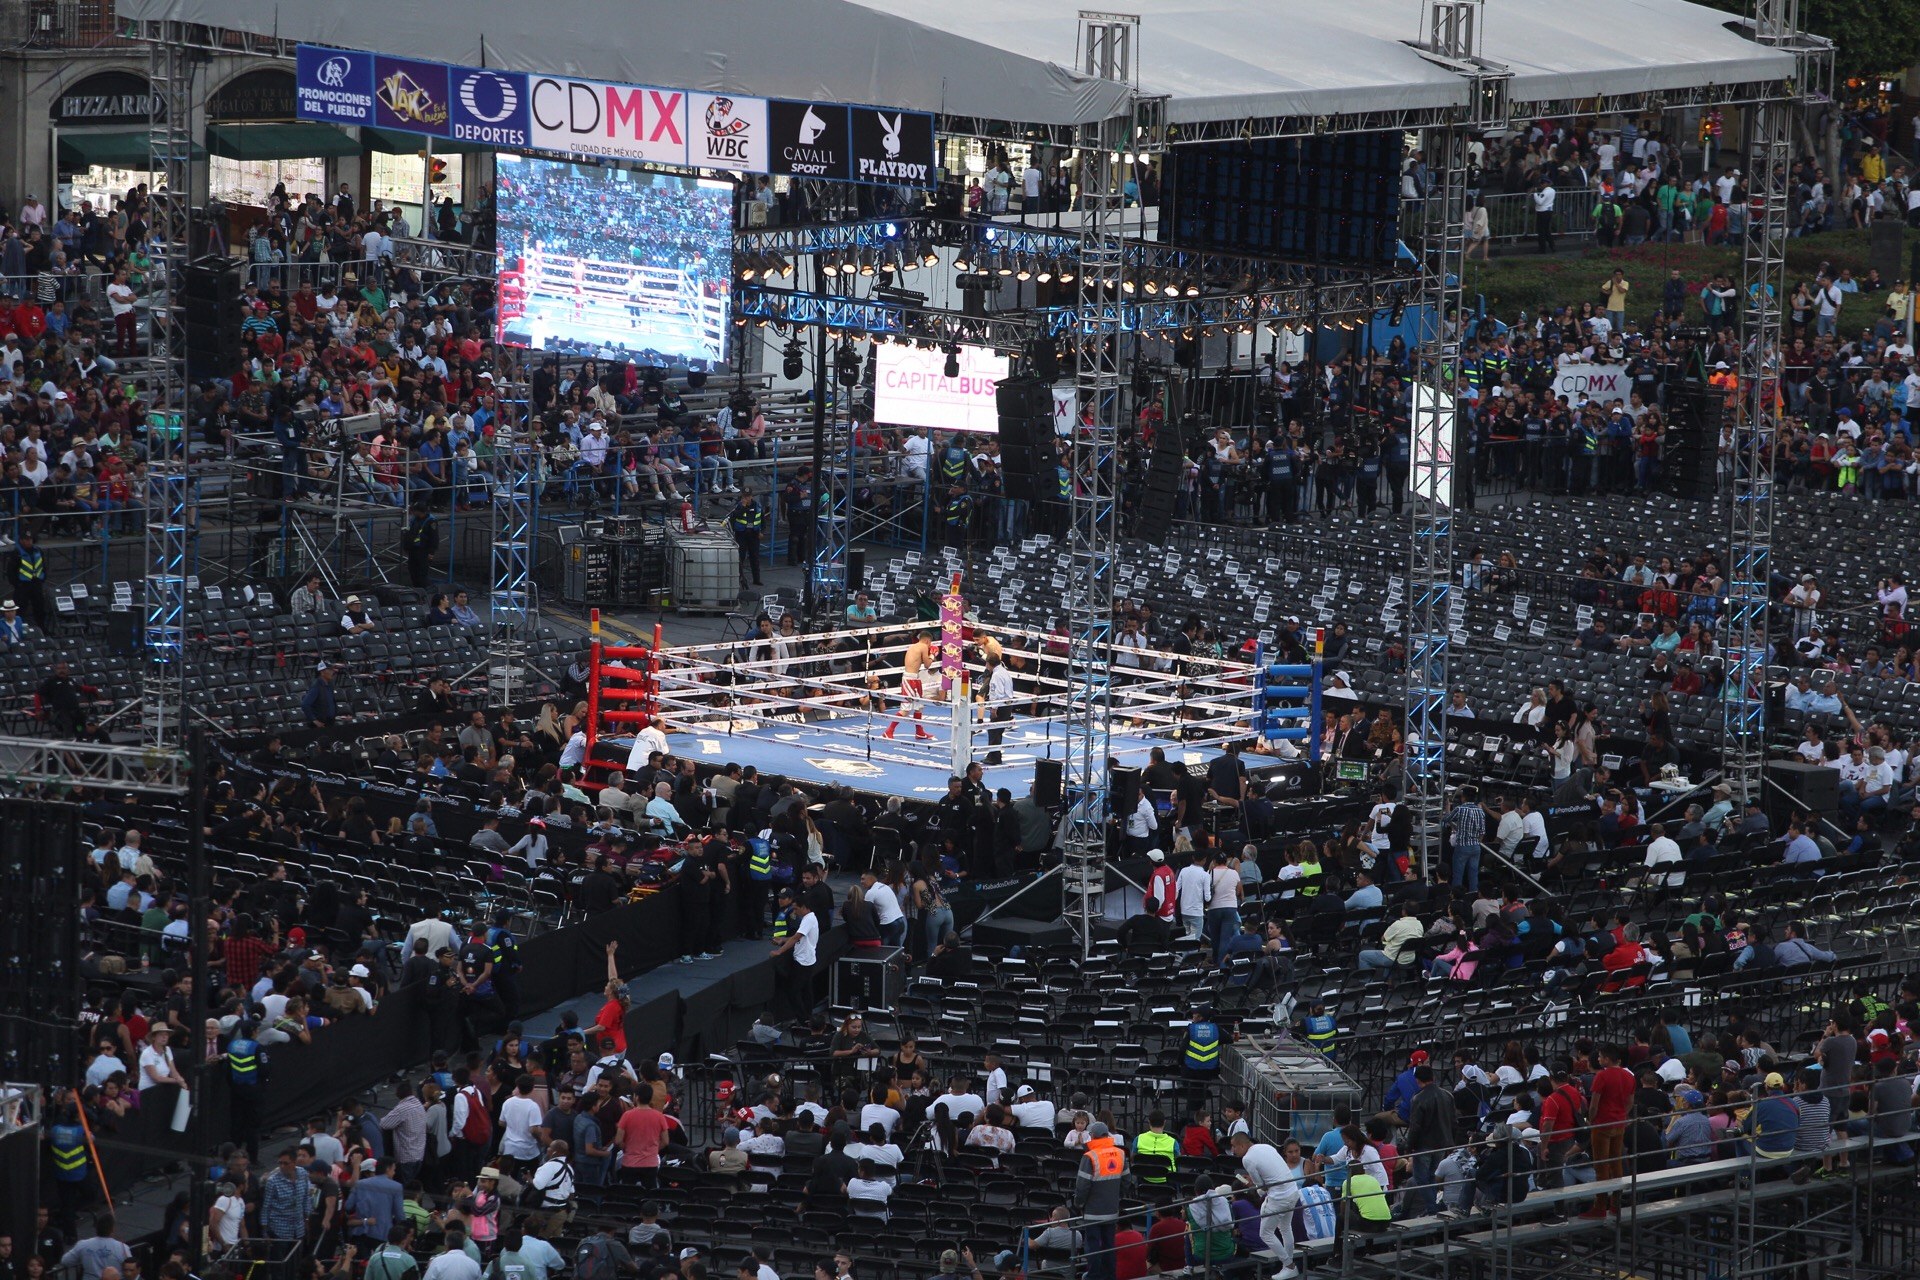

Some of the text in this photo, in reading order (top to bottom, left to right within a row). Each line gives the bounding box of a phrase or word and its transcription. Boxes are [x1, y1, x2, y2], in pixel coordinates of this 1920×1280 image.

[62, 95, 162, 117] BIZZARRO
[298, 87, 372, 107] PROMOCIONES
[383, 74, 424, 122] YAK
[304, 101, 366, 119] DEL PUEBLO
[532, 78, 683, 145] CDMX
[455, 124, 525, 146] DEPORTES
[570, 143, 644, 159] CIUDAD DE MÉXICO
[706, 136, 749, 159] WBC
[783, 146, 836, 165] CAVALL
[791, 163, 827, 175] SPORT
[859, 158, 927, 180] PLAYBOY
[886, 370, 995, 396] CAPITALBUS
[1561, 374, 1618, 393] CDMX
